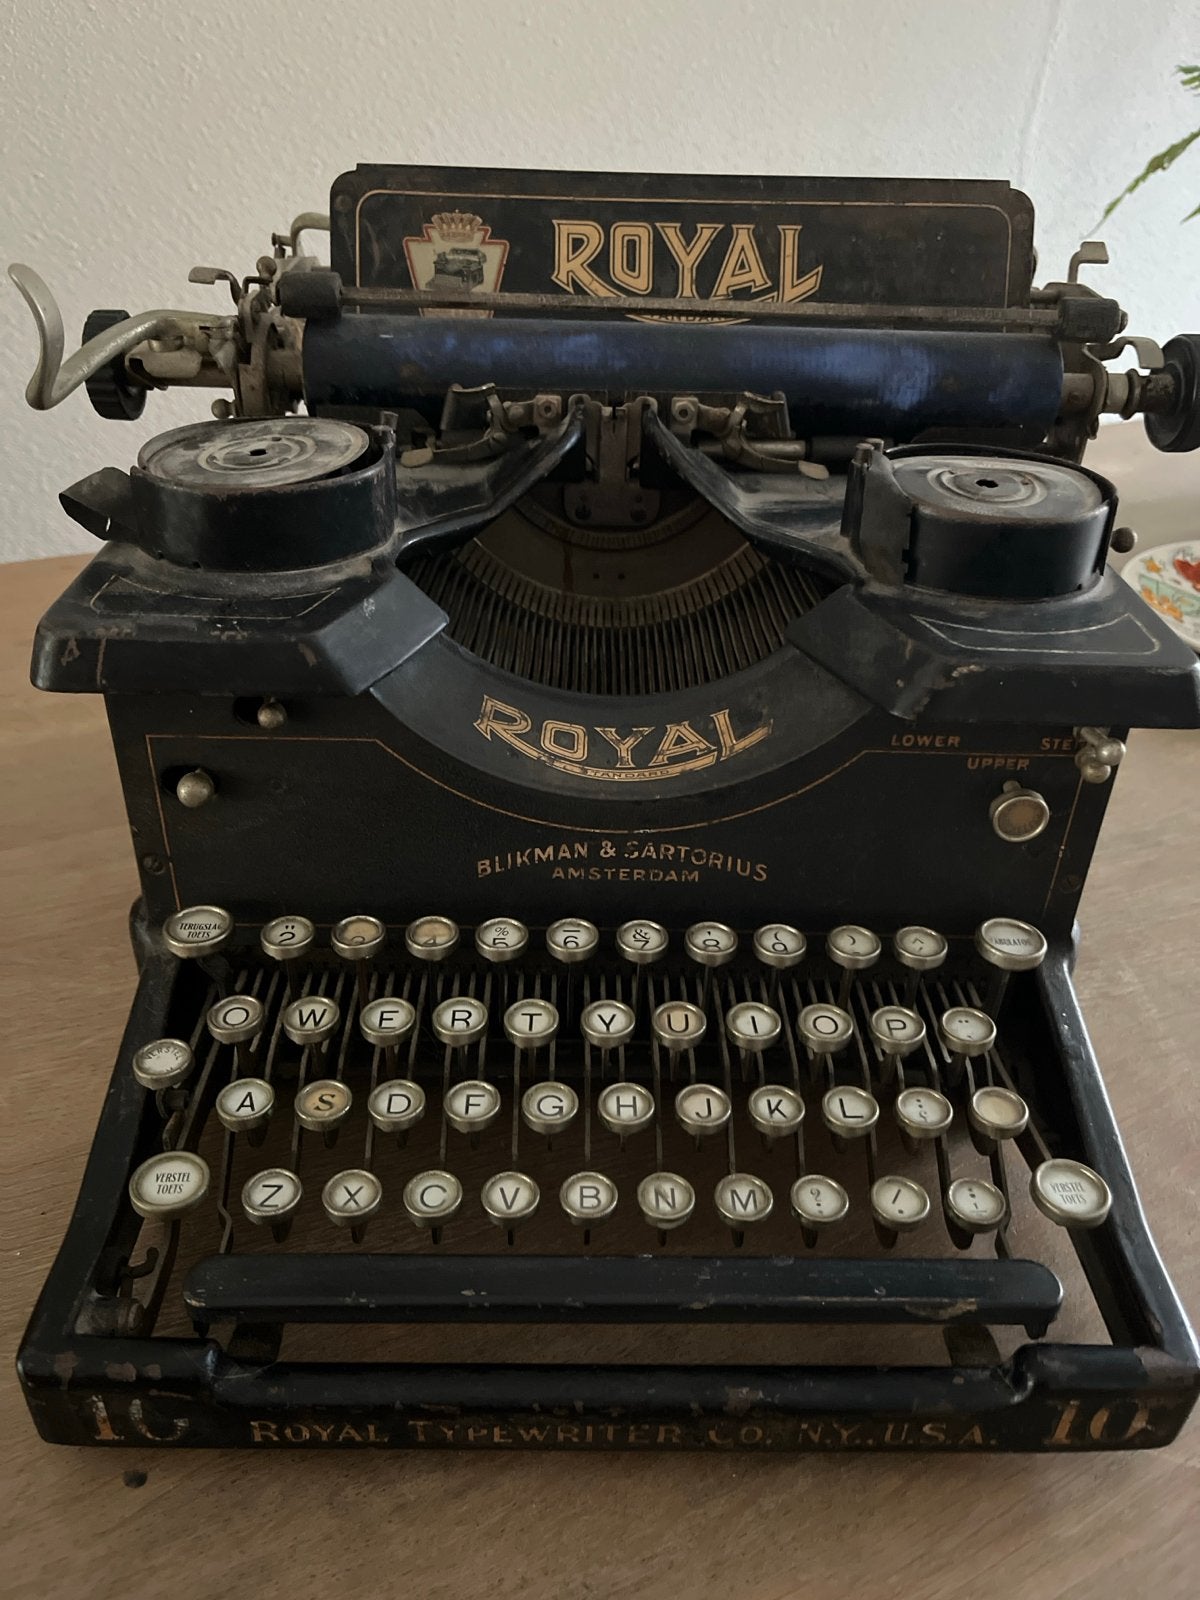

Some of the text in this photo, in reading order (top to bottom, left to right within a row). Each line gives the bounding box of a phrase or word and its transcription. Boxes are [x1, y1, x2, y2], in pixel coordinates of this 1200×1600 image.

[551, 219, 823, 303] ROYAL
[473, 694, 774, 768] ROYAL
[891, 733, 961, 748] LOWER
[584, 768, 670, 778] STANDARD
[967, 757, 1030, 771] UPPER
[477, 840, 769, 882] BLIKMAN & SARTORIUS
[552, 867, 699, 883] AMSTERDAM
[298, 1008, 327, 1027] W
[378, 1010, 400, 1029] E
[451, 1009, 472, 1029] R
[521, 1013, 542, 1031] T
[597, 1014, 616, 1032] Y
[667, 1013, 689, 1033] U
[751, 1015, 758, 1035] I
[813, 1015, 839, 1035] O
[886, 1019, 907, 1038] P
[236, 1091, 255, 1113] A
[314, 1093, 336, 1112] S
[386, 1093, 411, 1114] D
[464, 1094, 485, 1115] F
[537, 1094, 563, 1117] G
[616, 1095, 638, 1117] H
[695, 1098, 711, 1119] J
[766, 1098, 787, 1119] K
[839, 1098, 864, 1119] L
[155, 1172, 191, 1183] VERSTEL
[1050, 1182, 1085, 1194] VERSTEL
[156, 1184, 184, 1195] TOETS
[259, 1184, 283, 1208] Z
[342, 1185, 364, 1207] X
[420, 1184, 447, 1209] C
[499, 1187, 520, 1211] V
[579, 1186, 602, 1209] B
[653, 1187, 676, 1210] N
[1059, 1193, 1087, 1205] TOETS
[729, 1189, 758, 1212] M
[250, 1420, 389, 1442] ROYAL
[408, 1420, 681, 1443] TYPEWRITER
